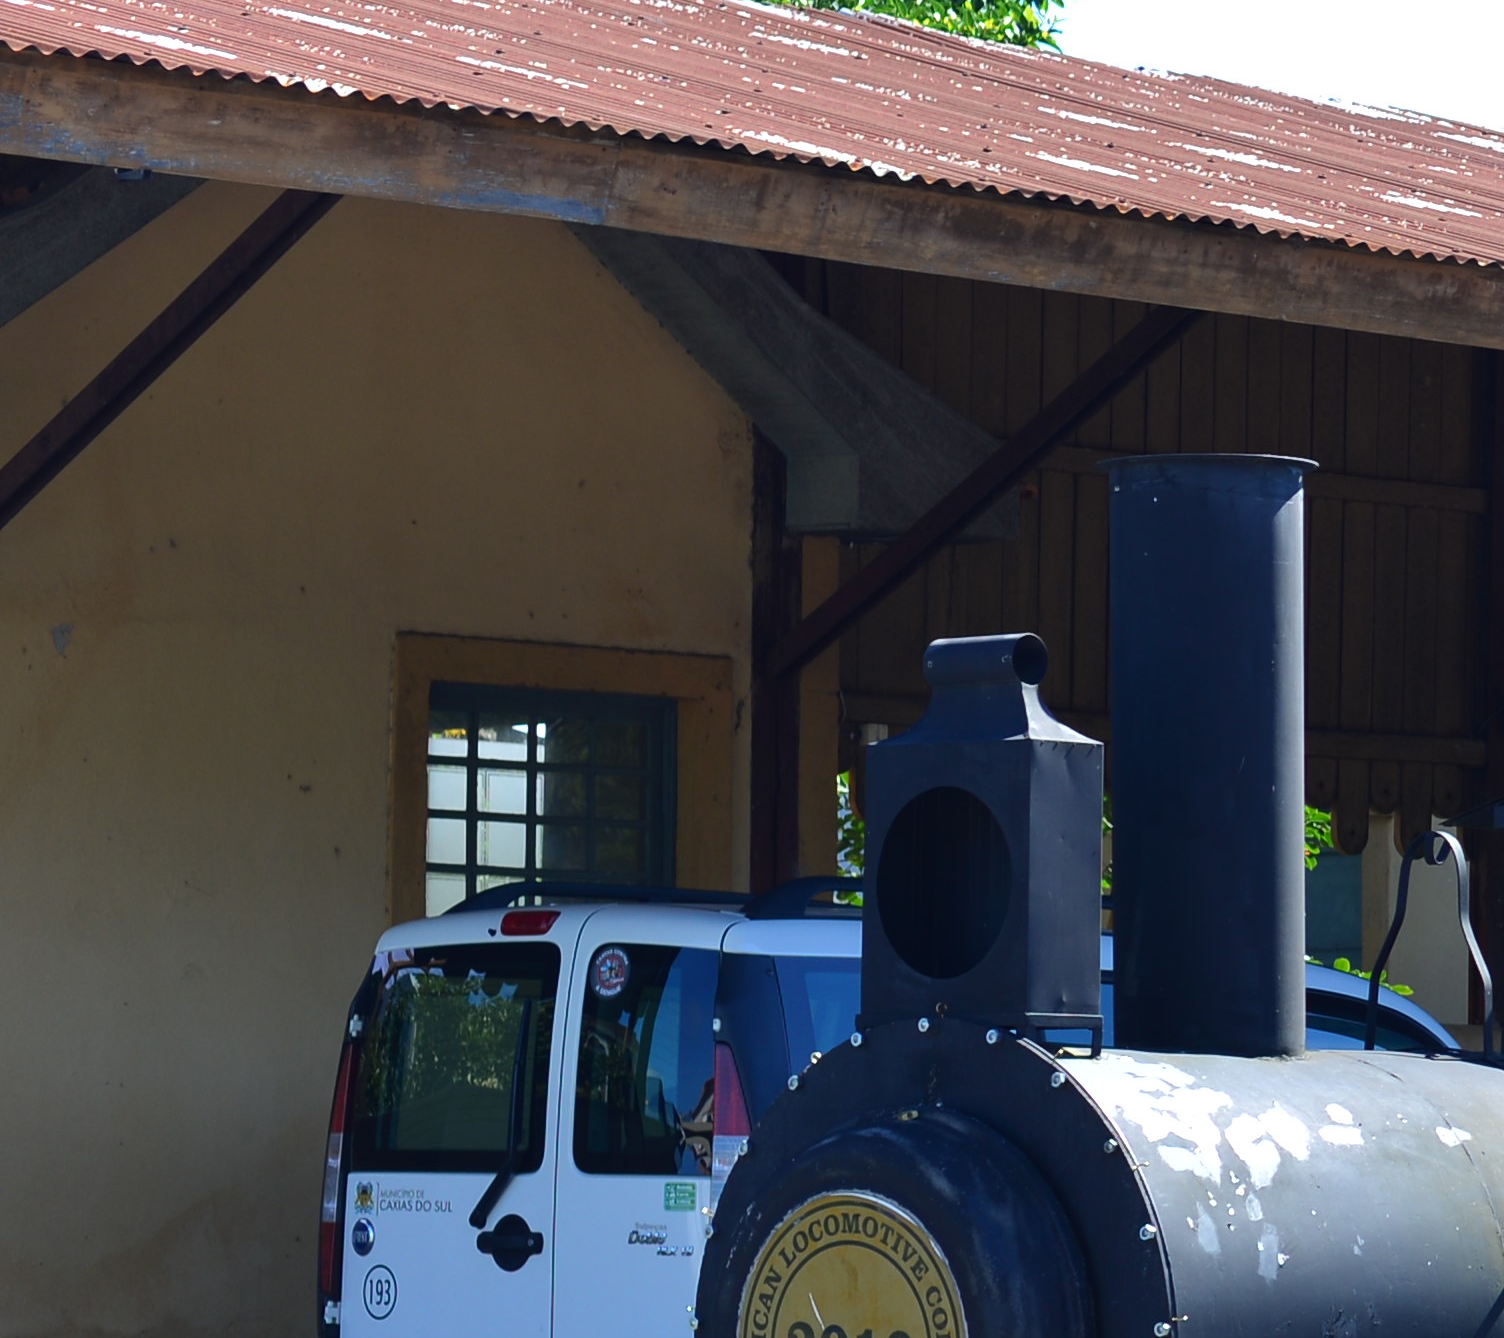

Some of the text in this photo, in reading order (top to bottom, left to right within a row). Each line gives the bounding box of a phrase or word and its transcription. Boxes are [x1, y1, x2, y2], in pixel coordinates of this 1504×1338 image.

[380, 1199, 452, 1213] CAXIAS DO SUL
[781, 1212, 930, 1282] LOCOMOTIVE
[370, 1279, 391, 1306] 193
